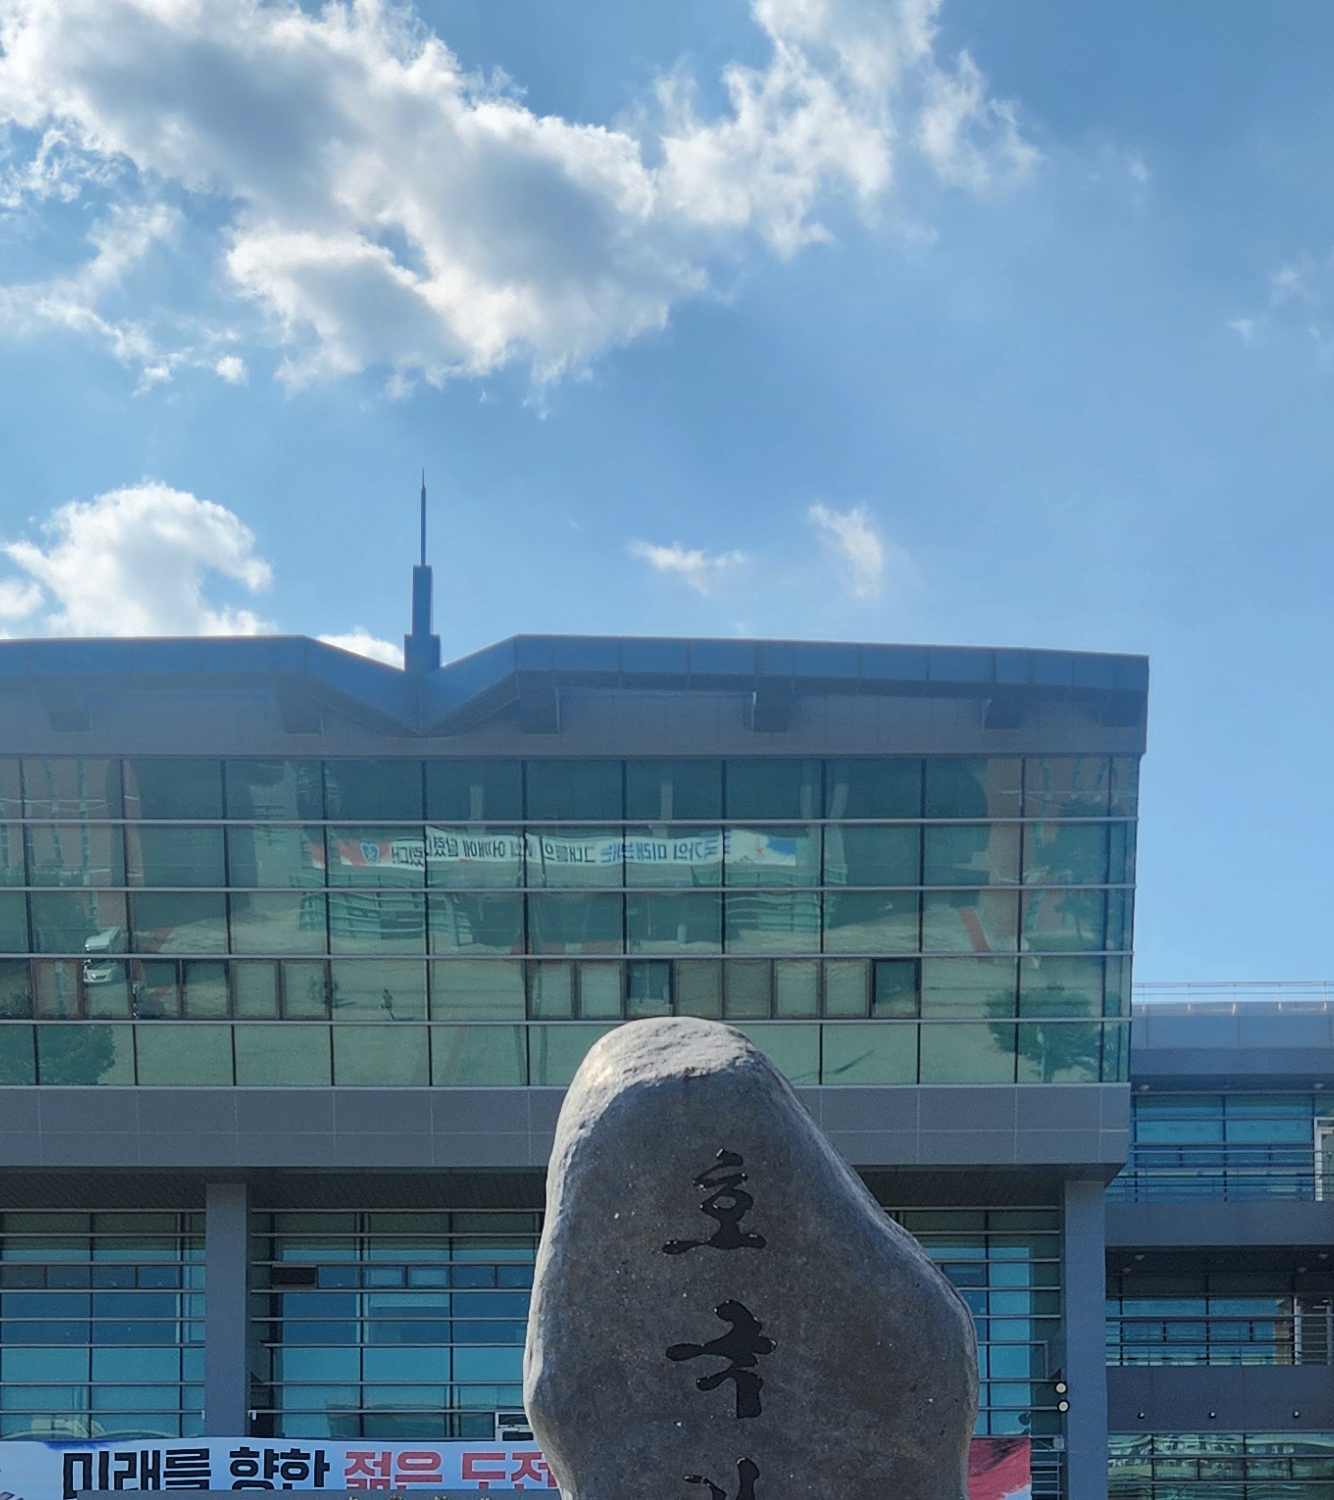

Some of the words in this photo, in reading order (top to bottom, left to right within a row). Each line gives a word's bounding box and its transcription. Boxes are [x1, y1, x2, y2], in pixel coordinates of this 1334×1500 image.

[62, 1448, 212, 1500] 미래를
[229, 1446, 331, 1491] 향한
[344, 1451, 443, 1491] 젊은
